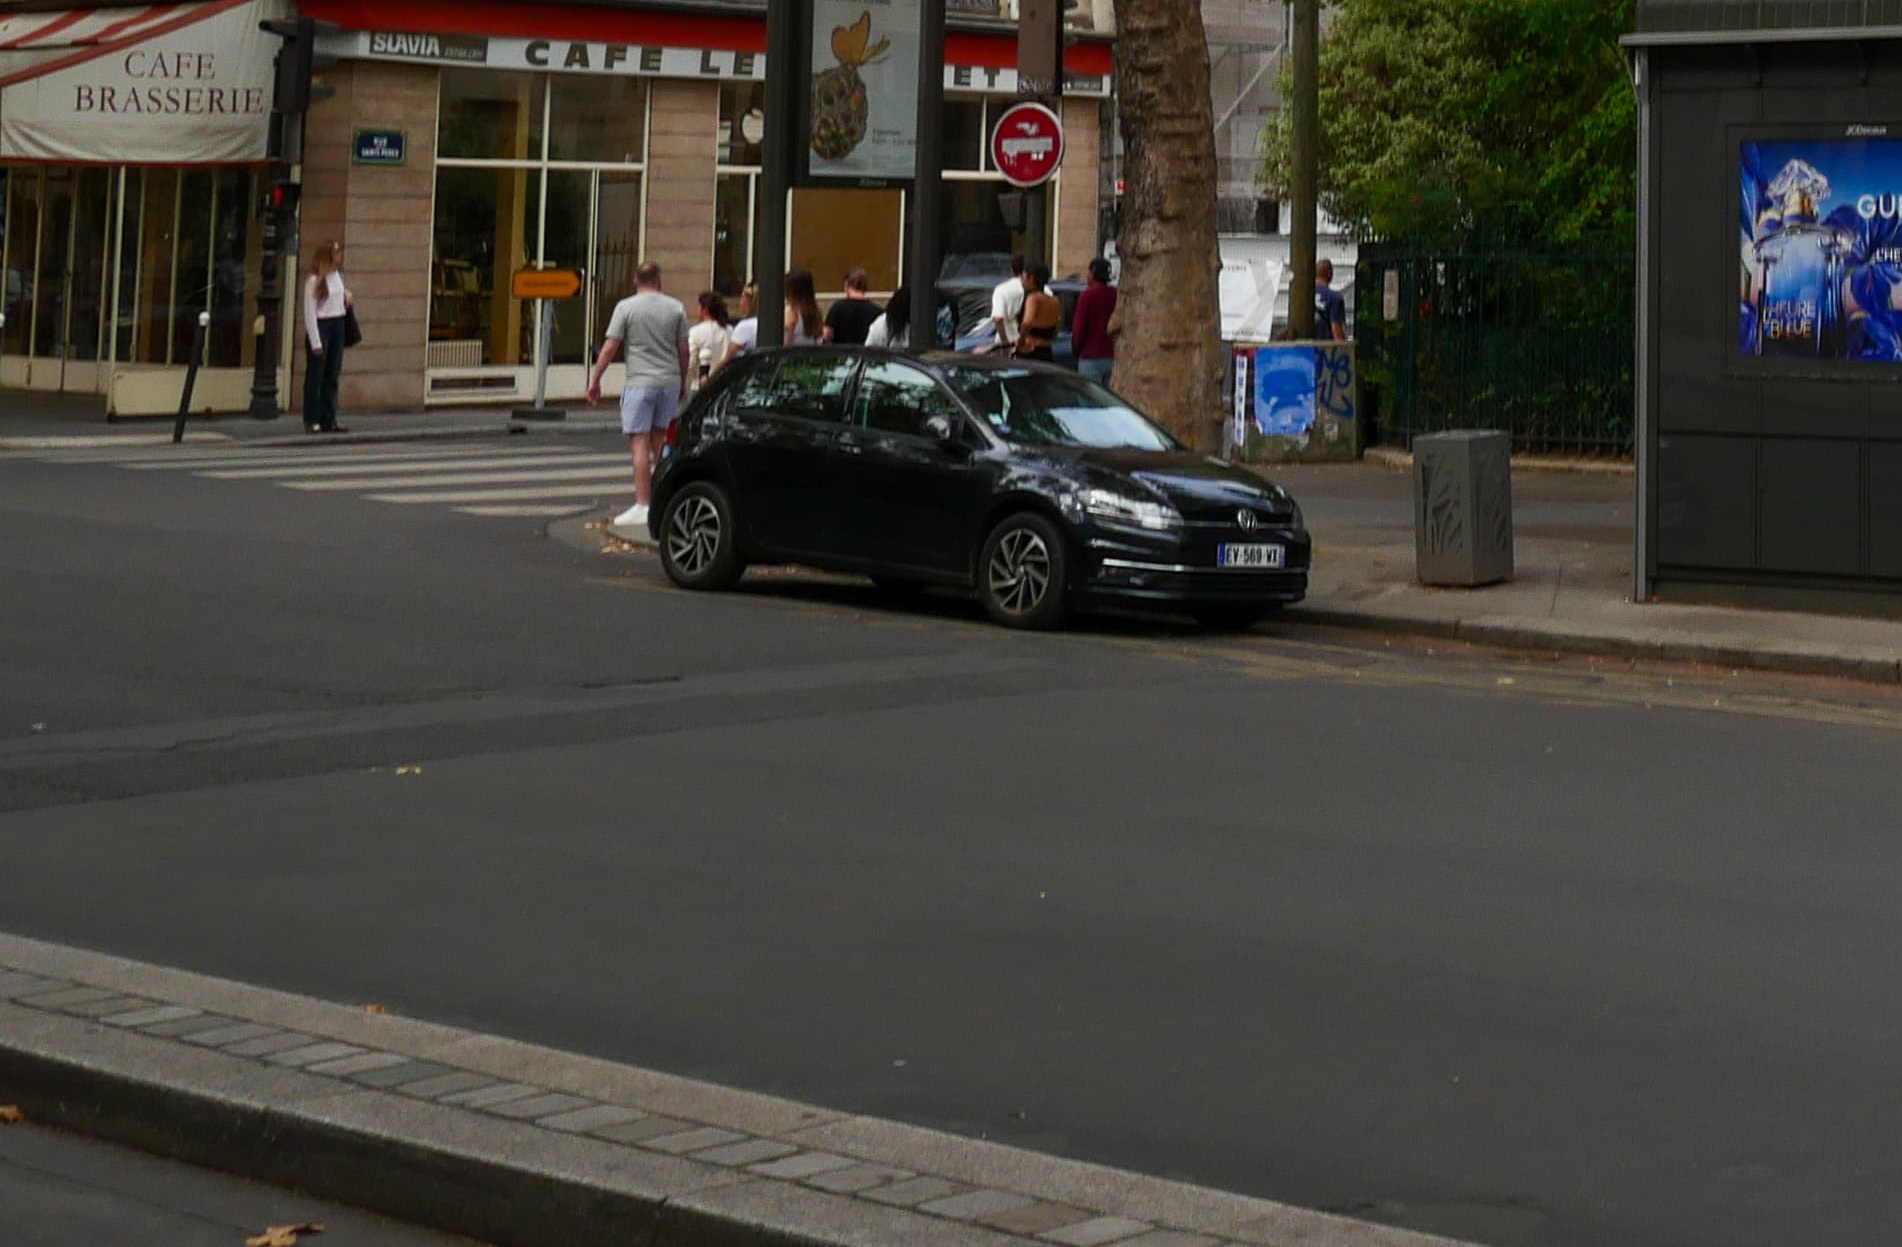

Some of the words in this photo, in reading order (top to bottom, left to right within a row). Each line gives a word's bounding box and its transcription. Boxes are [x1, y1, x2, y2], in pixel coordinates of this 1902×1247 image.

[373, 33, 440, 57] SLAVIA
[524, 40, 663, 72] CAFE
[701, 48, 755, 76] LE
[124, 50, 216, 80] CAFE
[75, 84, 264, 115] BRASSERIE
